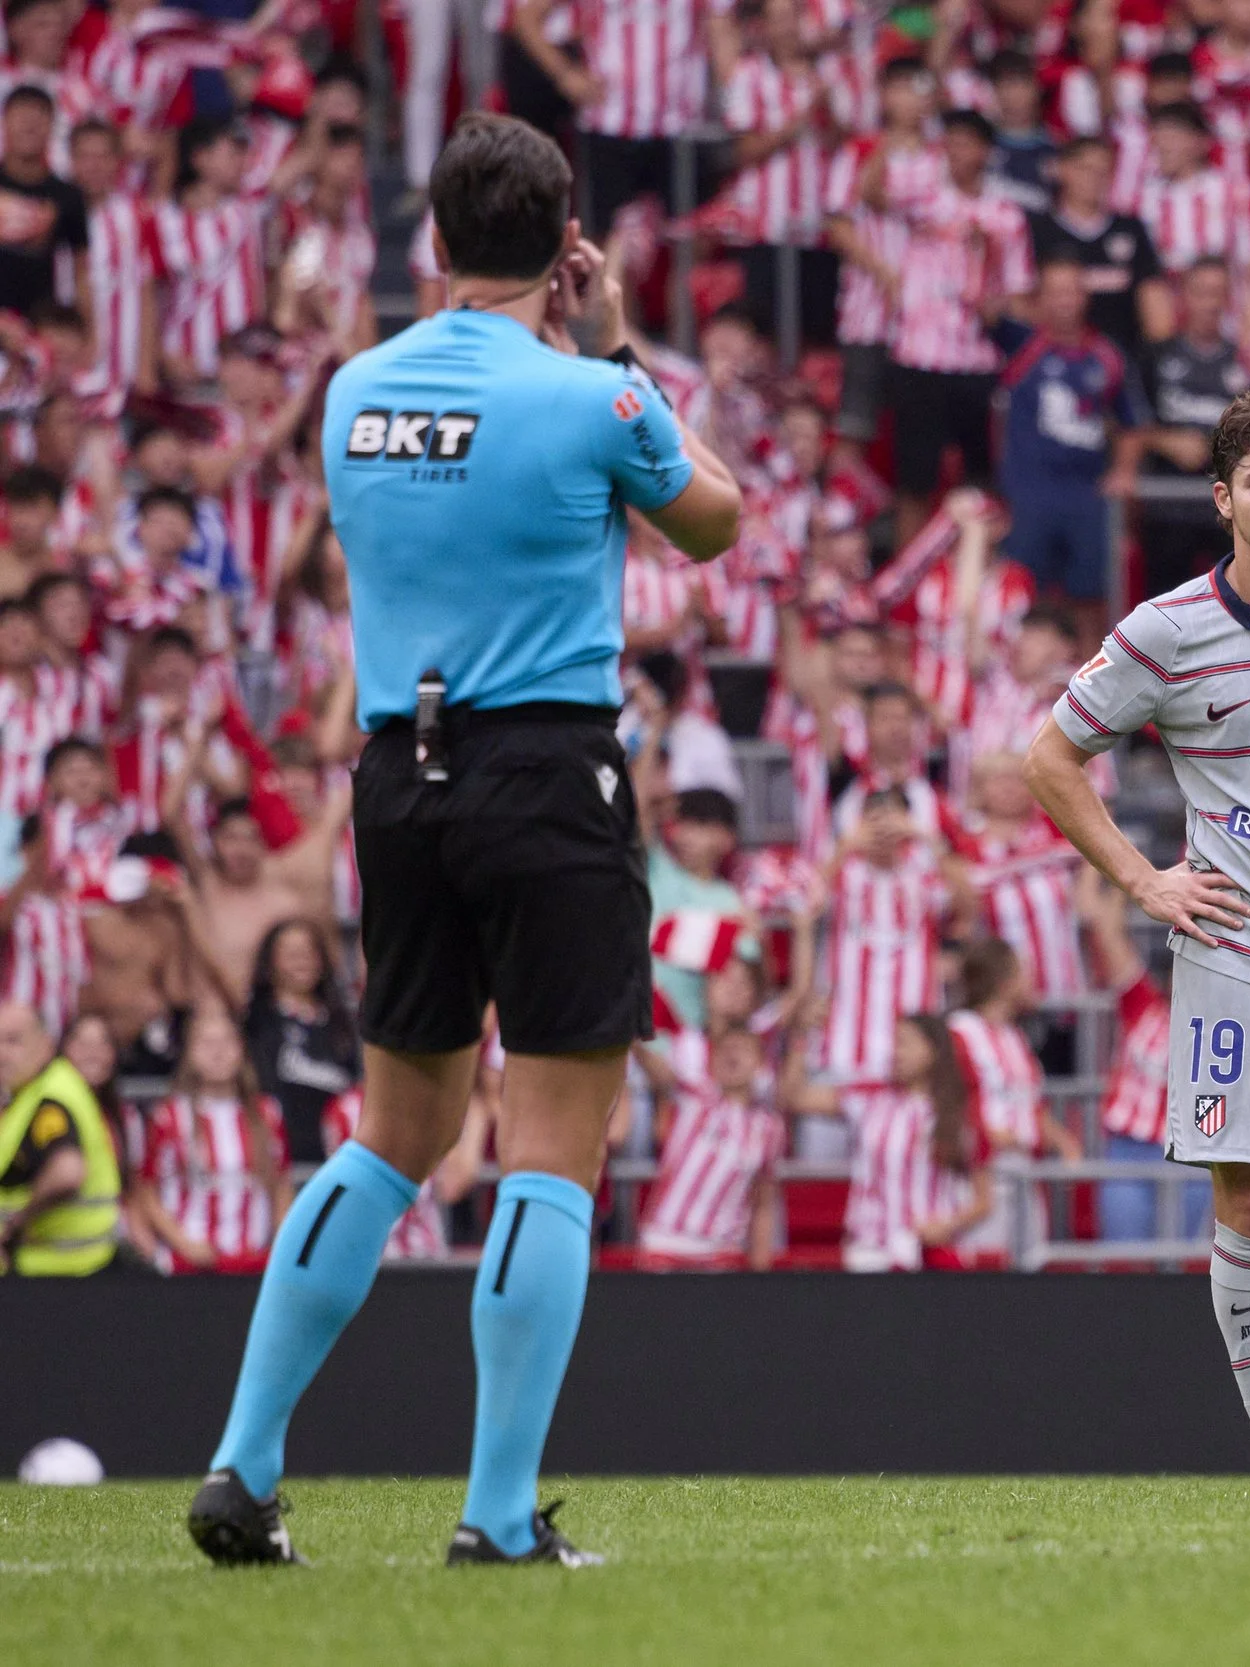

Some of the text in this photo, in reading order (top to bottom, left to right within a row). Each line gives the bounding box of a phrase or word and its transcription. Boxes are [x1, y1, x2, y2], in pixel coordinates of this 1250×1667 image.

[348, 412, 477, 457] BKT
[410, 468, 467, 483] TIRES
[1189, 1016, 1246, 1086] 19
